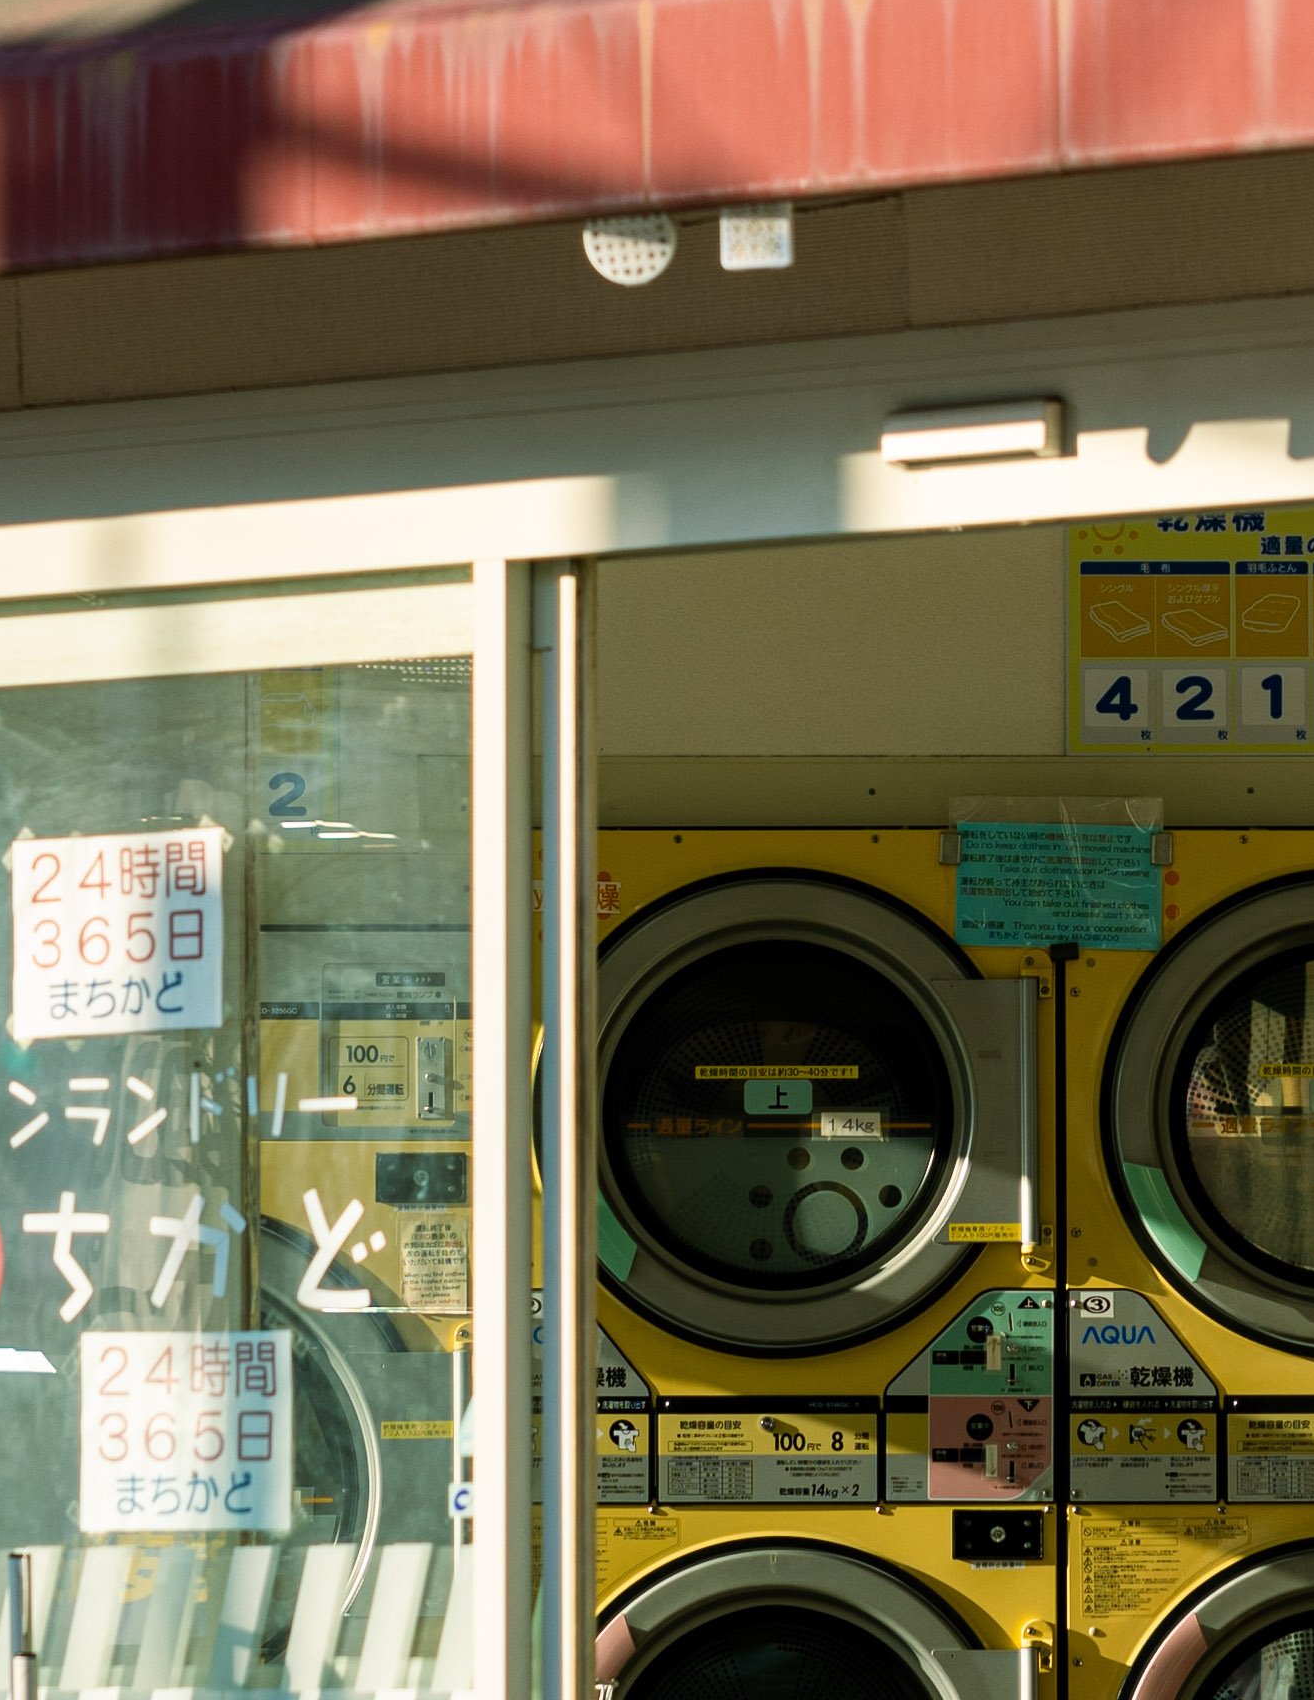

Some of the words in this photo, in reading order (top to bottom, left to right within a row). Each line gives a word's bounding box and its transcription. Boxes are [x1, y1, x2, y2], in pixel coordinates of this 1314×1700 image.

[1247, 563, 1297, 575] 羽毛ふとん
[1099, 583, 1135, 593] シングル
[1095, 676, 1139, 721] 4
[1175, 676, 1215, 721] 2
[1261, 674, 1283, 720] 1
[1141, 730, 1151, 741] 枚
[1218, 730, 1228, 741] 枚
[1296, 730, 1306, 741] 枚
[268, 772, 307, 816] 2
[31, 841, 207, 904] 24時間
[1003, 899, 1020, 908] You
[32, 909, 204, 970] 365日
[48, 972, 185, 1018] まちかど
[342, 1075, 356, 1095] 6
[768, 1085, 789, 1109] 上
[1082, 1325, 1155, 1344] AQUA
[99, 1343, 275, 1400] 24時間
[1129, 1366, 1194, 1387] 乾燥機
[680, 1420, 741, 1430] 乾燥容量の目安
[1249, 1420, 1310, 1430] 乾燥容量の目安
[99, 1410, 272, 1464] 365日
[831, 1432, 844, 1451] 8
[117, 1473, 252, 1517] まちかど
